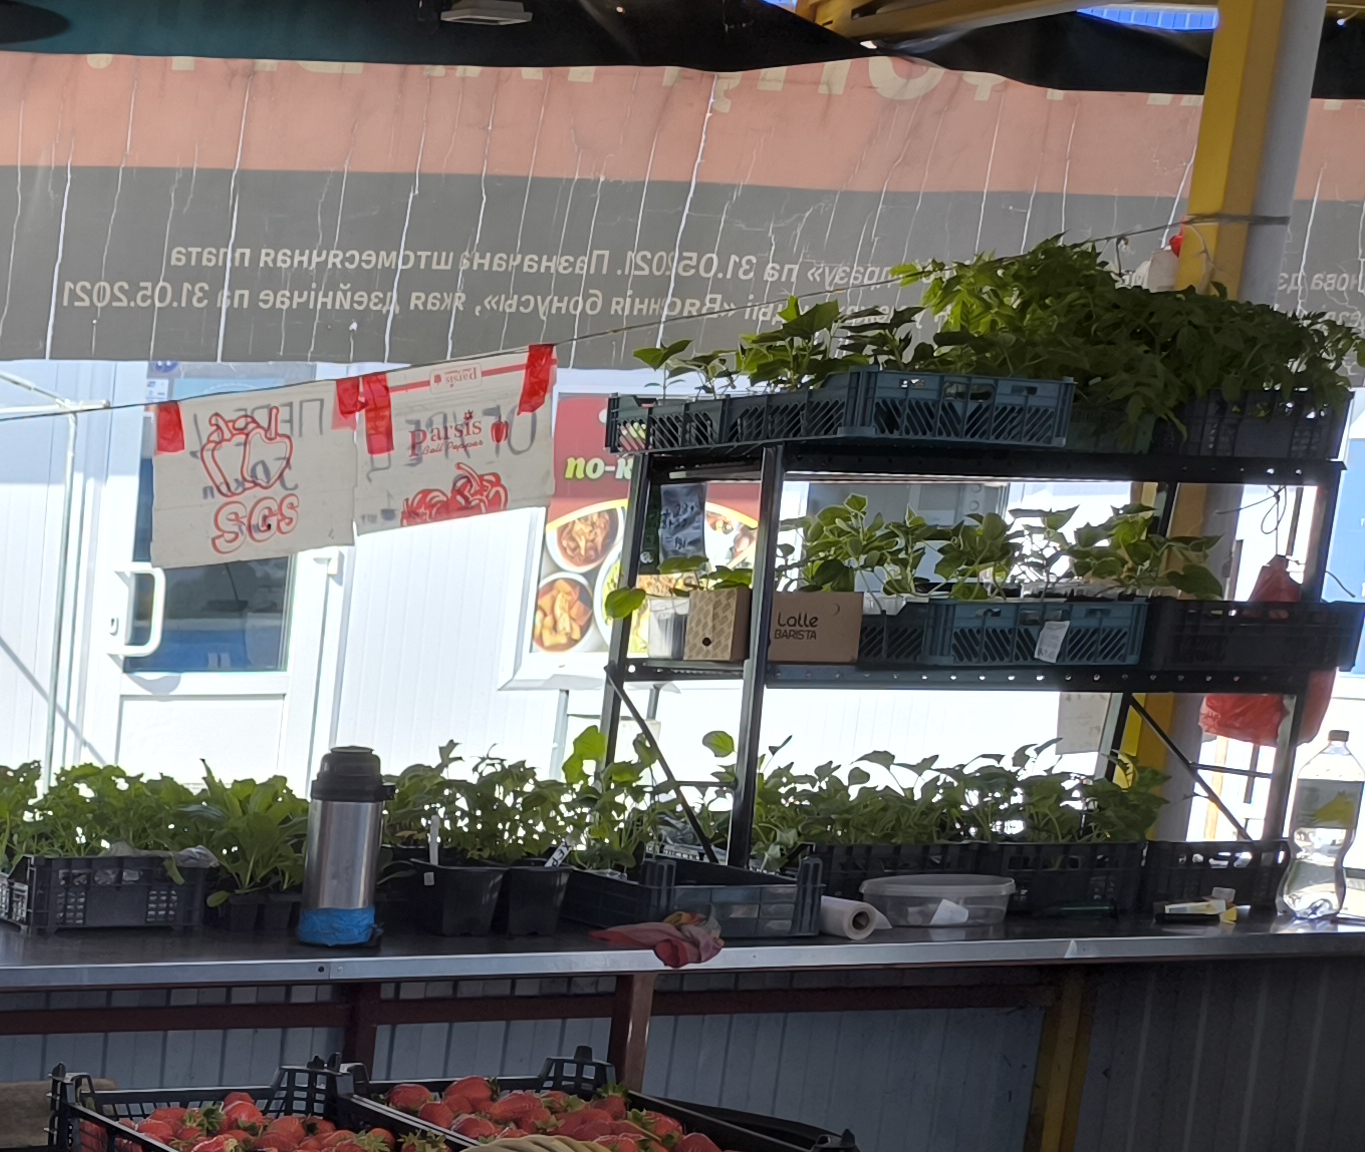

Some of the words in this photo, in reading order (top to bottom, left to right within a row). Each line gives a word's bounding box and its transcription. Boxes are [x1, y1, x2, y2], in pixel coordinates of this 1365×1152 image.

[408, 409, 482, 458] Parsis
[212, 494, 300, 554] SGS
[774, 628, 817, 641] BARISTA
